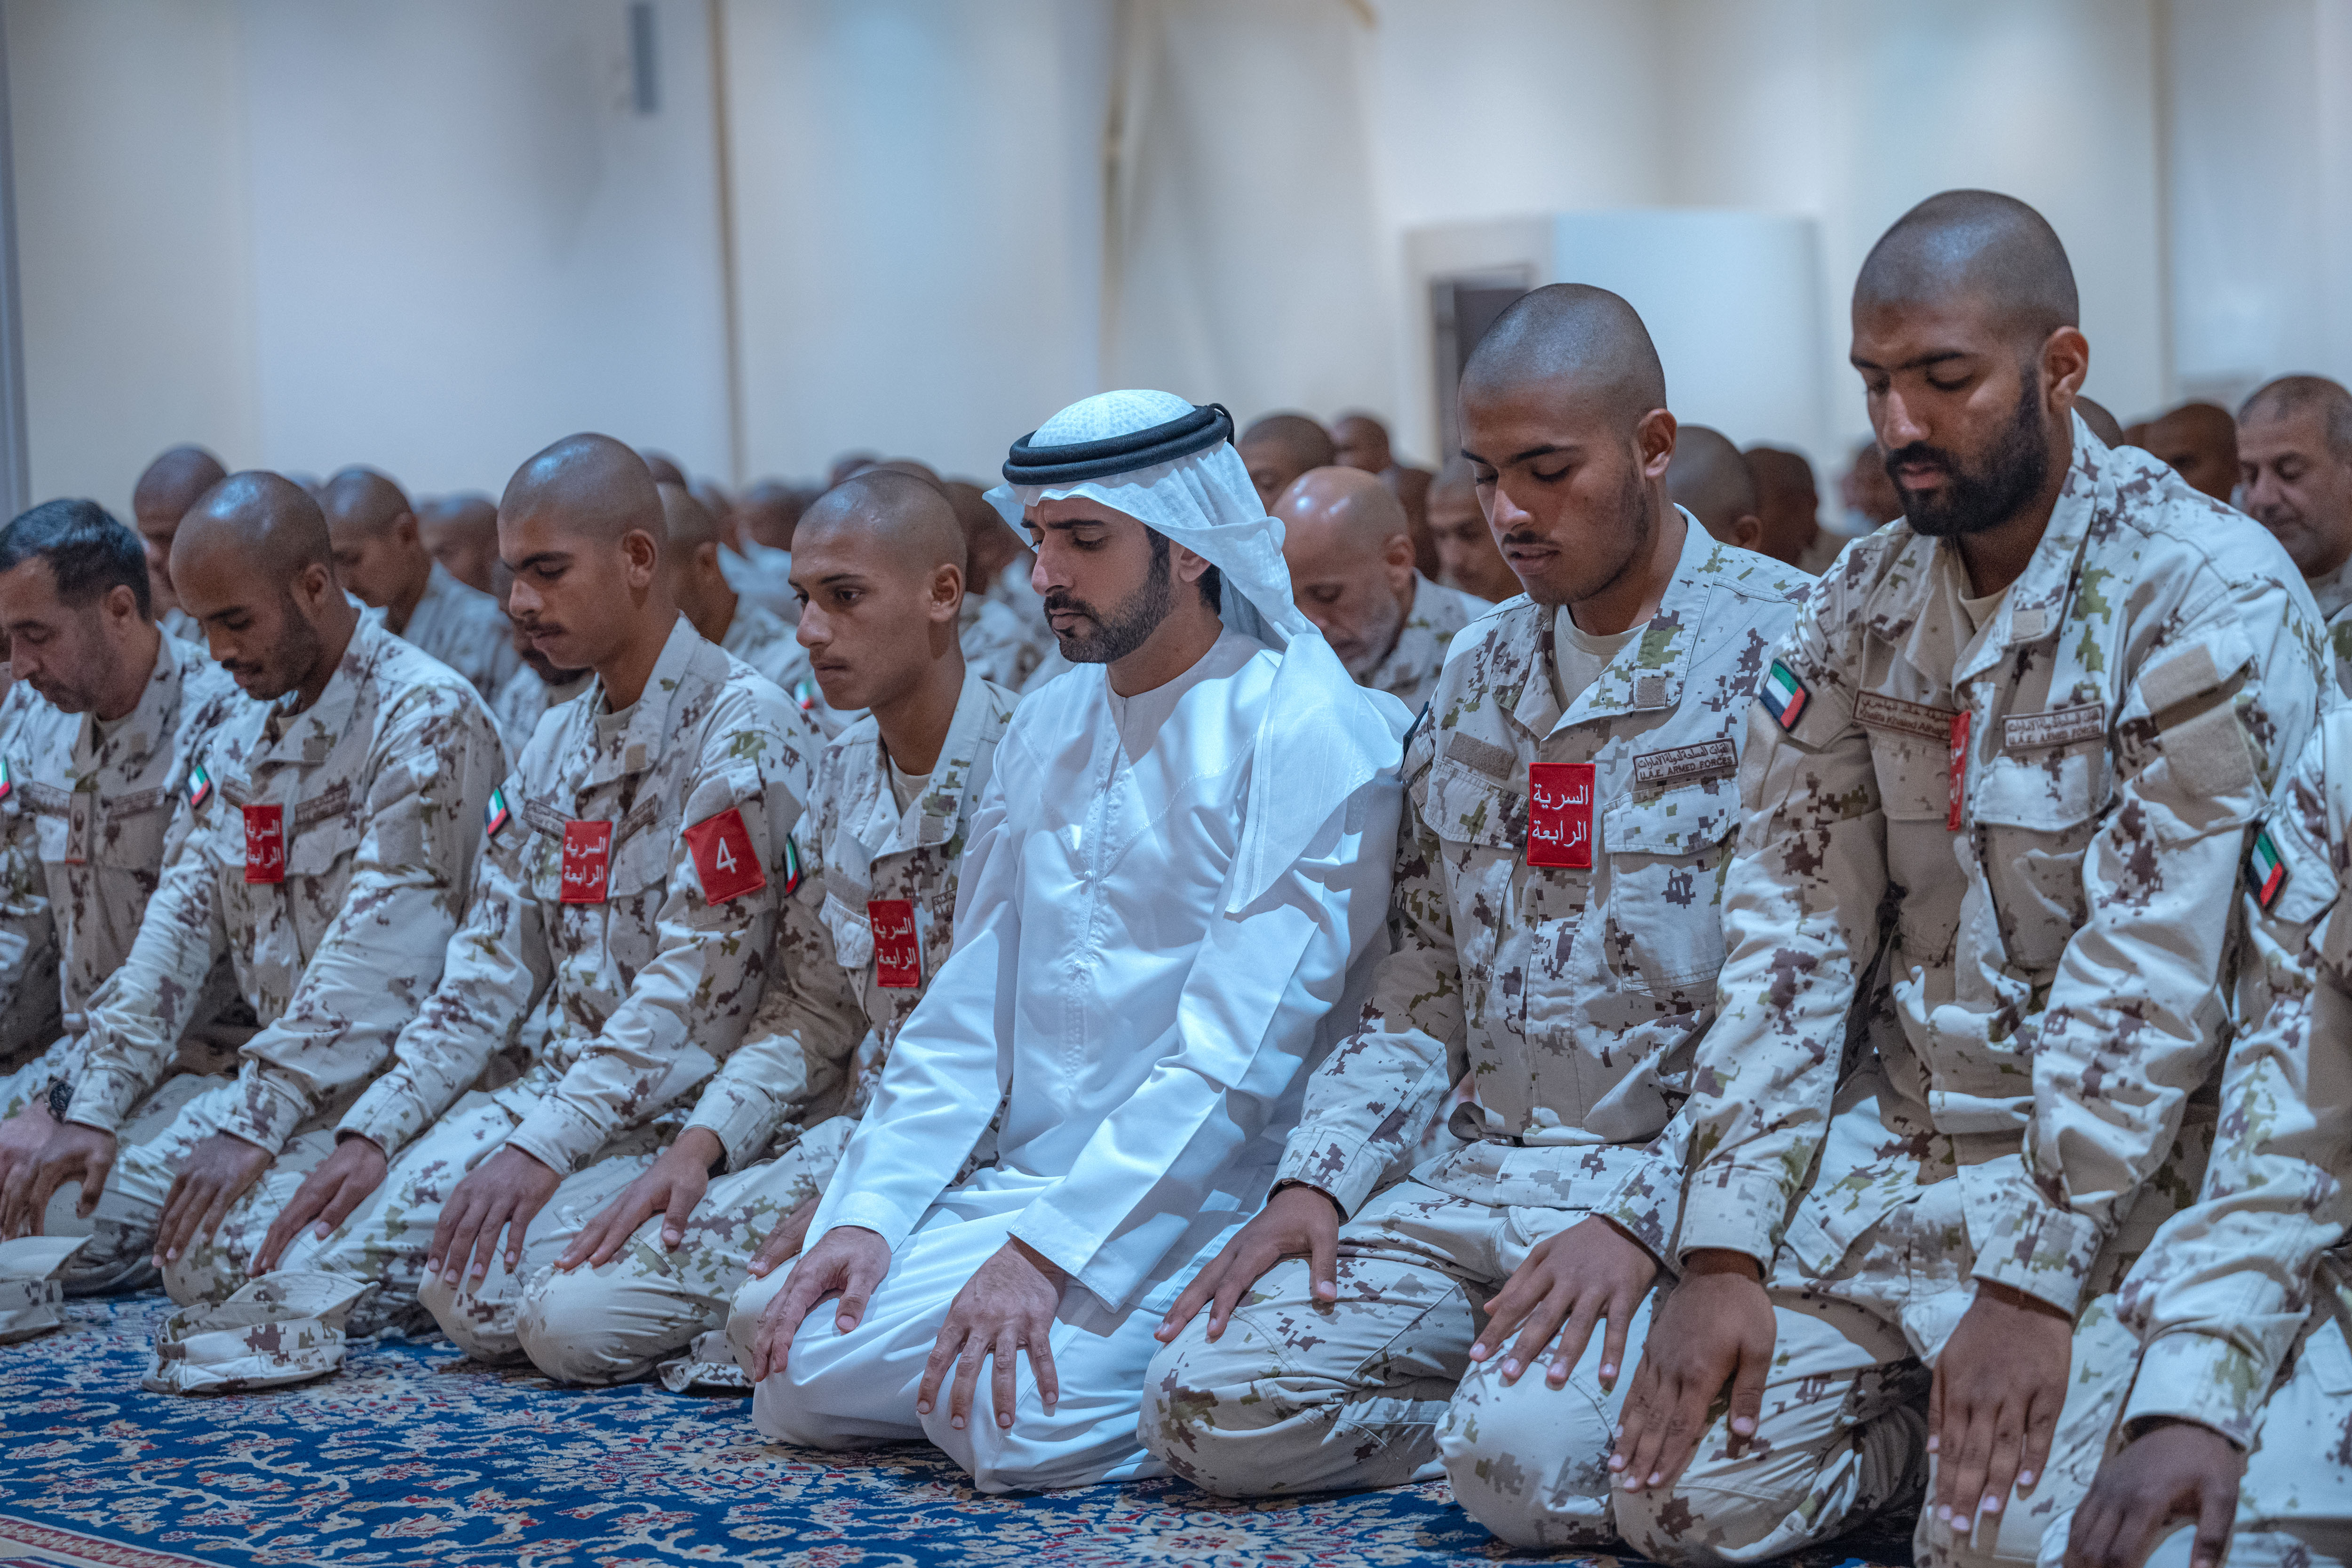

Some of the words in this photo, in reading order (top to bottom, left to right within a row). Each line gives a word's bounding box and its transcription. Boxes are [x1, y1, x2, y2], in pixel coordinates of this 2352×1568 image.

[1640, 769, 1664, 779] U.A.E.
[1668, 763, 1695, 775] ARMED
[1699, 756, 1733, 769] FORCES
[1533, 783, 1588, 810] السرية
[246, 820, 279, 842] السرية
[1532, 820, 1587, 847] الرابعة
[248, 846, 281, 868] الرابعة
[565, 836, 606, 859] السرية
[716, 837, 737, 874] 4
[564, 865, 604, 888] الرابعة
[873, 917, 912, 940] السرية
[878, 947, 916, 970] الرابعة
